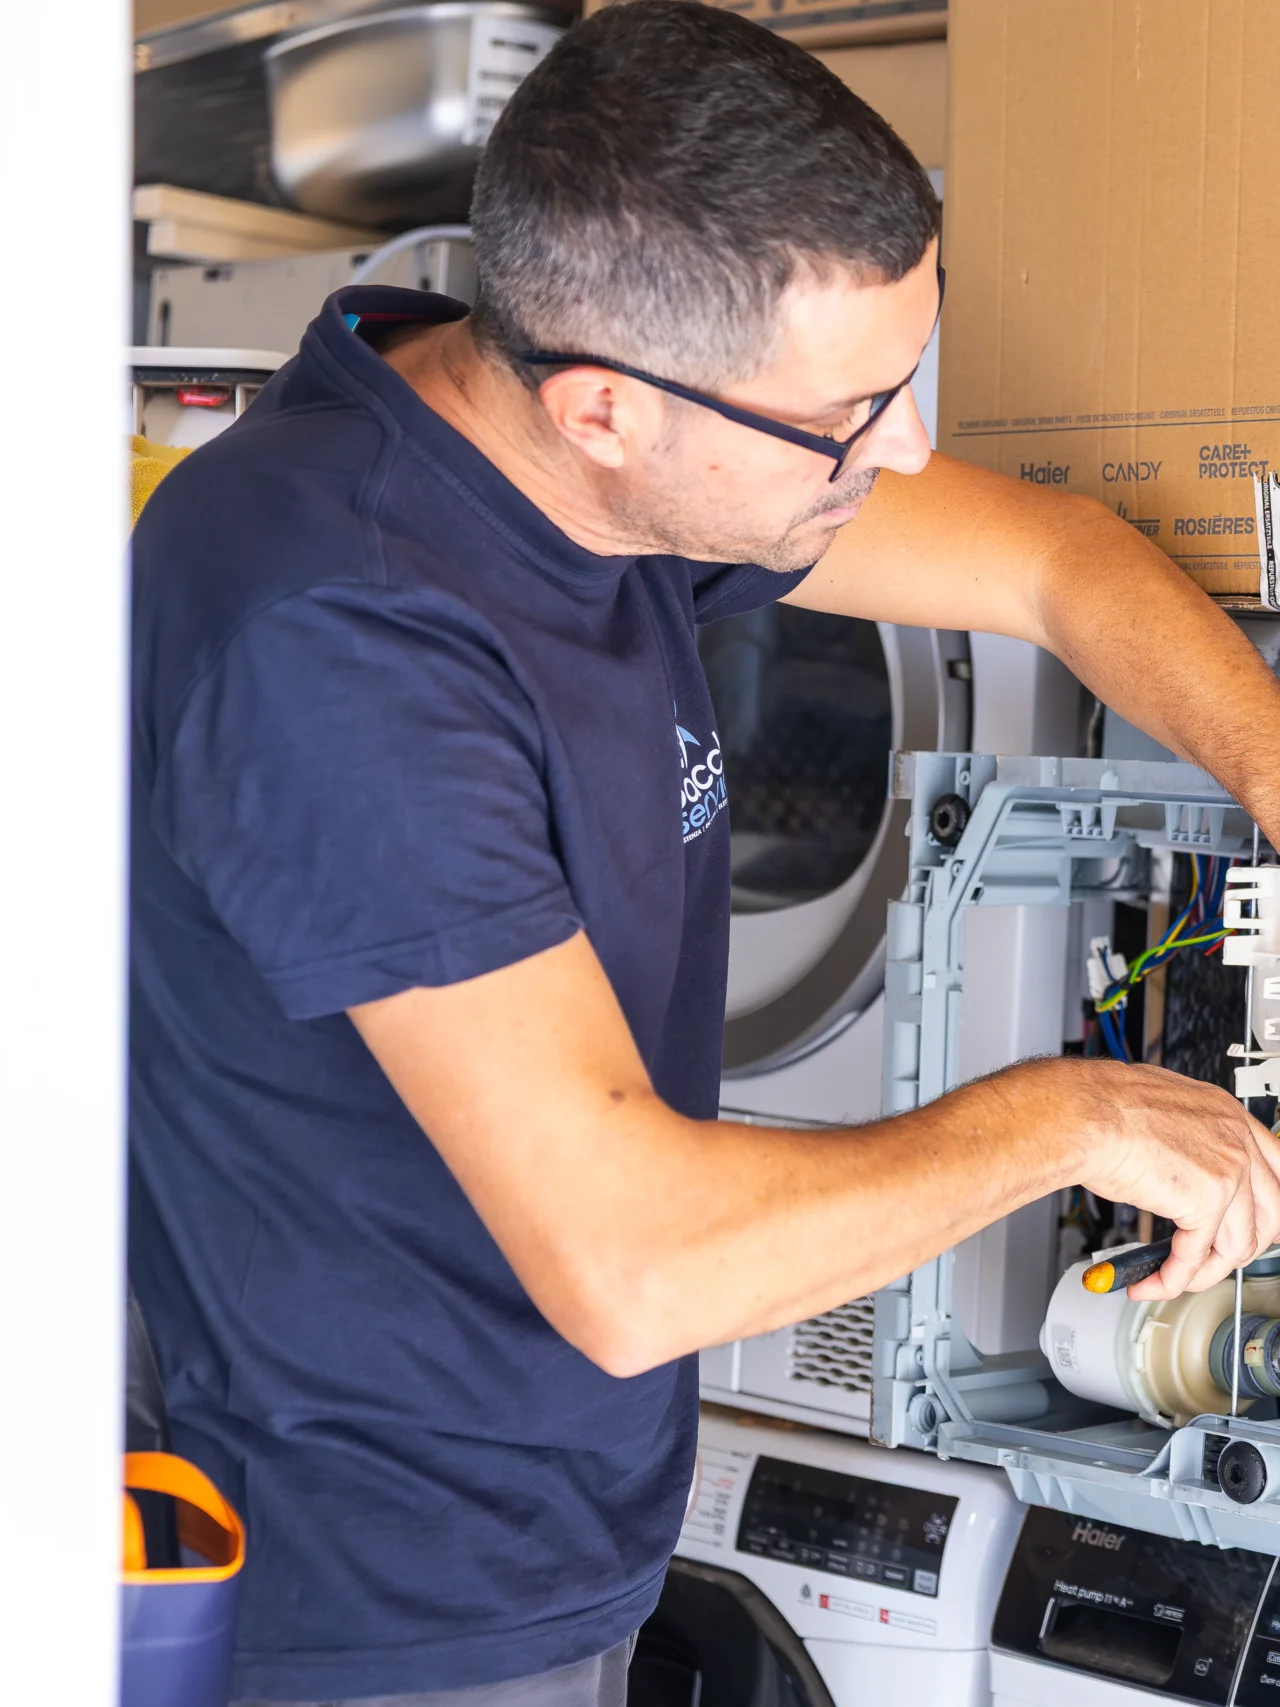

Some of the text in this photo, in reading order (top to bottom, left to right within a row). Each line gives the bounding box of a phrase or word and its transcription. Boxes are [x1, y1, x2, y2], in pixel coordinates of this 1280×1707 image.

[1231, 405, 1264, 416] REPUESTOS
[1020, 460, 1070, 485] Haier
[1102, 461, 1162, 483] CANDY
[1199, 460, 1269, 479] PROTECT
[1072, 1521, 1126, 1551] Haier
